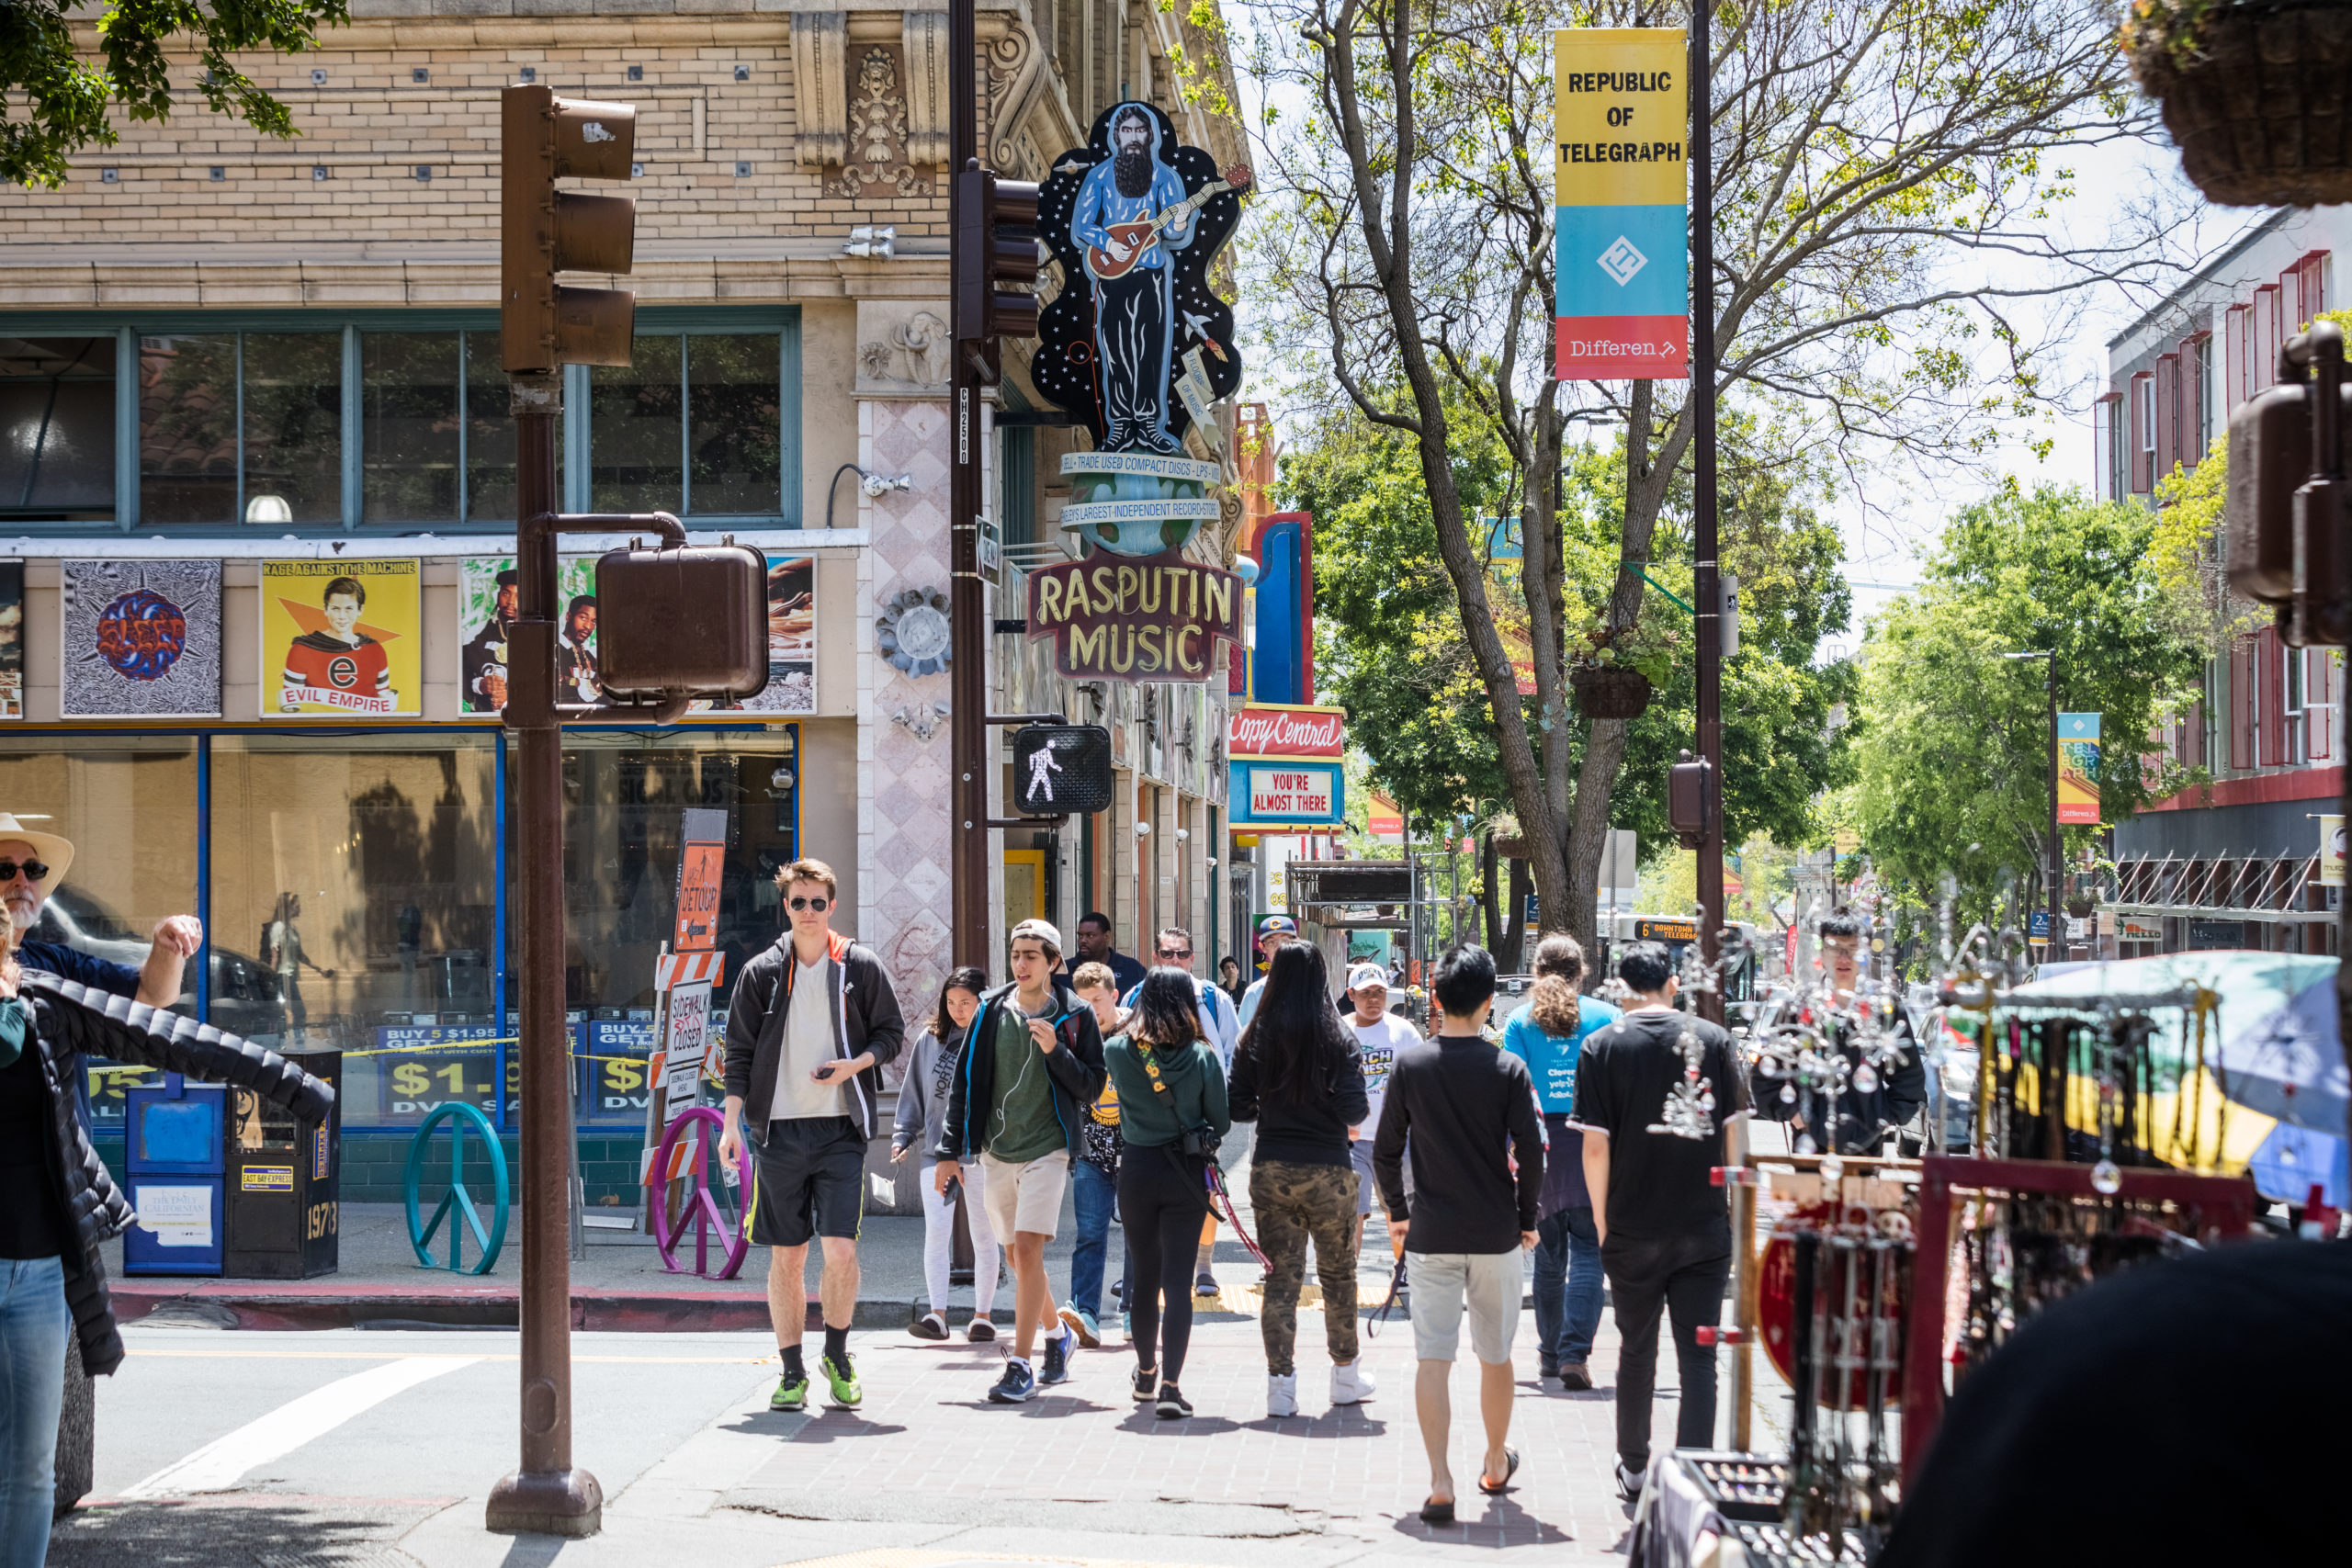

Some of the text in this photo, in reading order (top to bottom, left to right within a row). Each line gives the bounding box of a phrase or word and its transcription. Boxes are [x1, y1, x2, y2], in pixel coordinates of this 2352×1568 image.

[1568, 72, 1671, 93] REPUBLIC
[1606, 107, 1634, 127] OF
[1559, 142, 1680, 164] TELEGRAPH
[1182, 384, 1204, 416] OF MUSIC
[1078, 456, 1100, 468] TRADE
[1102, 457, 1124, 469] USED
[1125, 457, 1167, 473] COMPACT
[1169, 462, 1191, 475] DISCS
[1080, 505, 1112, 520] LARGEST
[1114, 503, 1170, 517] INDEPENDENT
[1173, 502, 1202, 515] RECORD
[263, 561, 415, 576] RAGE AGAINST THE MACHINE
[1037, 565, 1232, 625] RASPUTIN
[1070, 624, 1204, 672] MUSIC
[285, 685, 391, 713] EVIL EMPIRE
[1229, 712, 1342, 755] Copy Central
[1272, 773, 1309, 791] YOU'RE
[1253, 794, 1327, 811] ALMOST THERE
[682, 886, 717, 912] DETOUR
[1269, 919, 1282, 930] C
[1642, 923, 1693, 937] 6 DOWNTOWN
[1664, 931, 1698, 940] TELEGRAP
[673, 994, 708, 1019] SIDEWALK
[387, 1030, 426, 1039] BUY
[431, 1029, 442, 1039] 5
[447, 1028, 497, 1039] $1.95
[599, 1034, 649, 1043] GET
[600, 1024, 639, 1034] BUY
[387, 1039, 435, 1049] GET
[674, 1028, 701, 1052] CLOSED
[932, 1050, 951, 1075] THE
[934, 1055, 956, 1100] NORTH
[243, 1174, 256, 1182] EAST
[267, 1175, 292, 1183] EXPRESS
